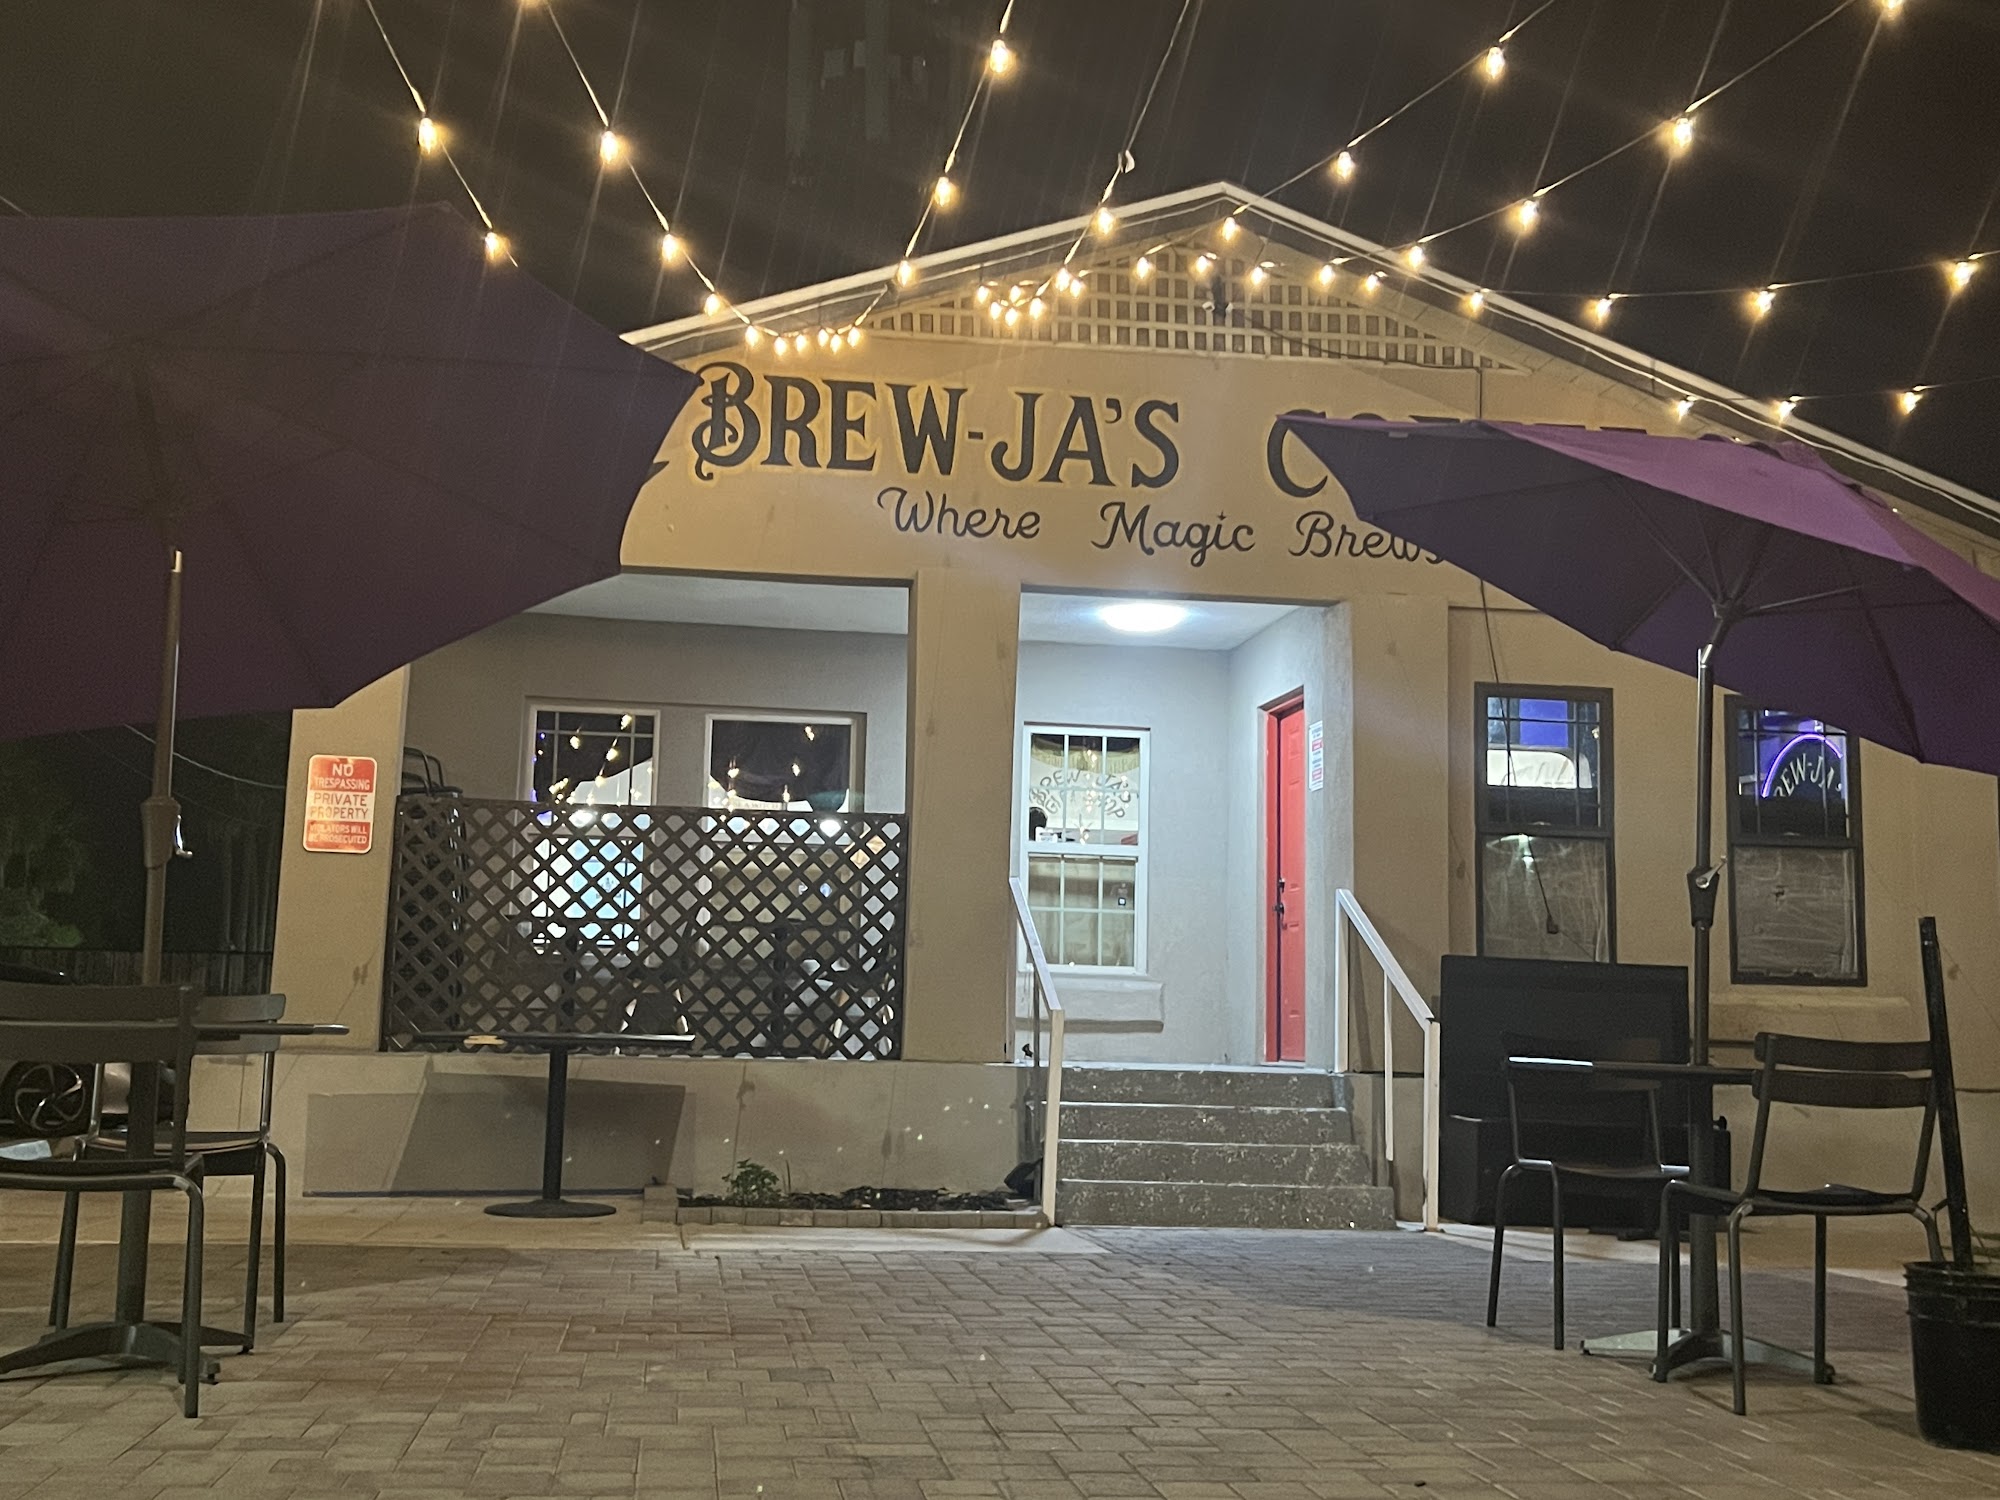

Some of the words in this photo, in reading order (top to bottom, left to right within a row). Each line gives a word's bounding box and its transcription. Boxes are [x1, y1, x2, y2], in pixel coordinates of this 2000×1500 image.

[691, 361, 1180, 489] BREW-JA'S
[877, 486, 1041, 540] Where
[1091, 501, 1256, 567] Magic
[332, 763, 354, 777] NO
[314, 777, 371, 790] TRESPASSING
[314, 792, 368, 807] PRIVATE
[310, 806, 368, 819] PROPERTY
